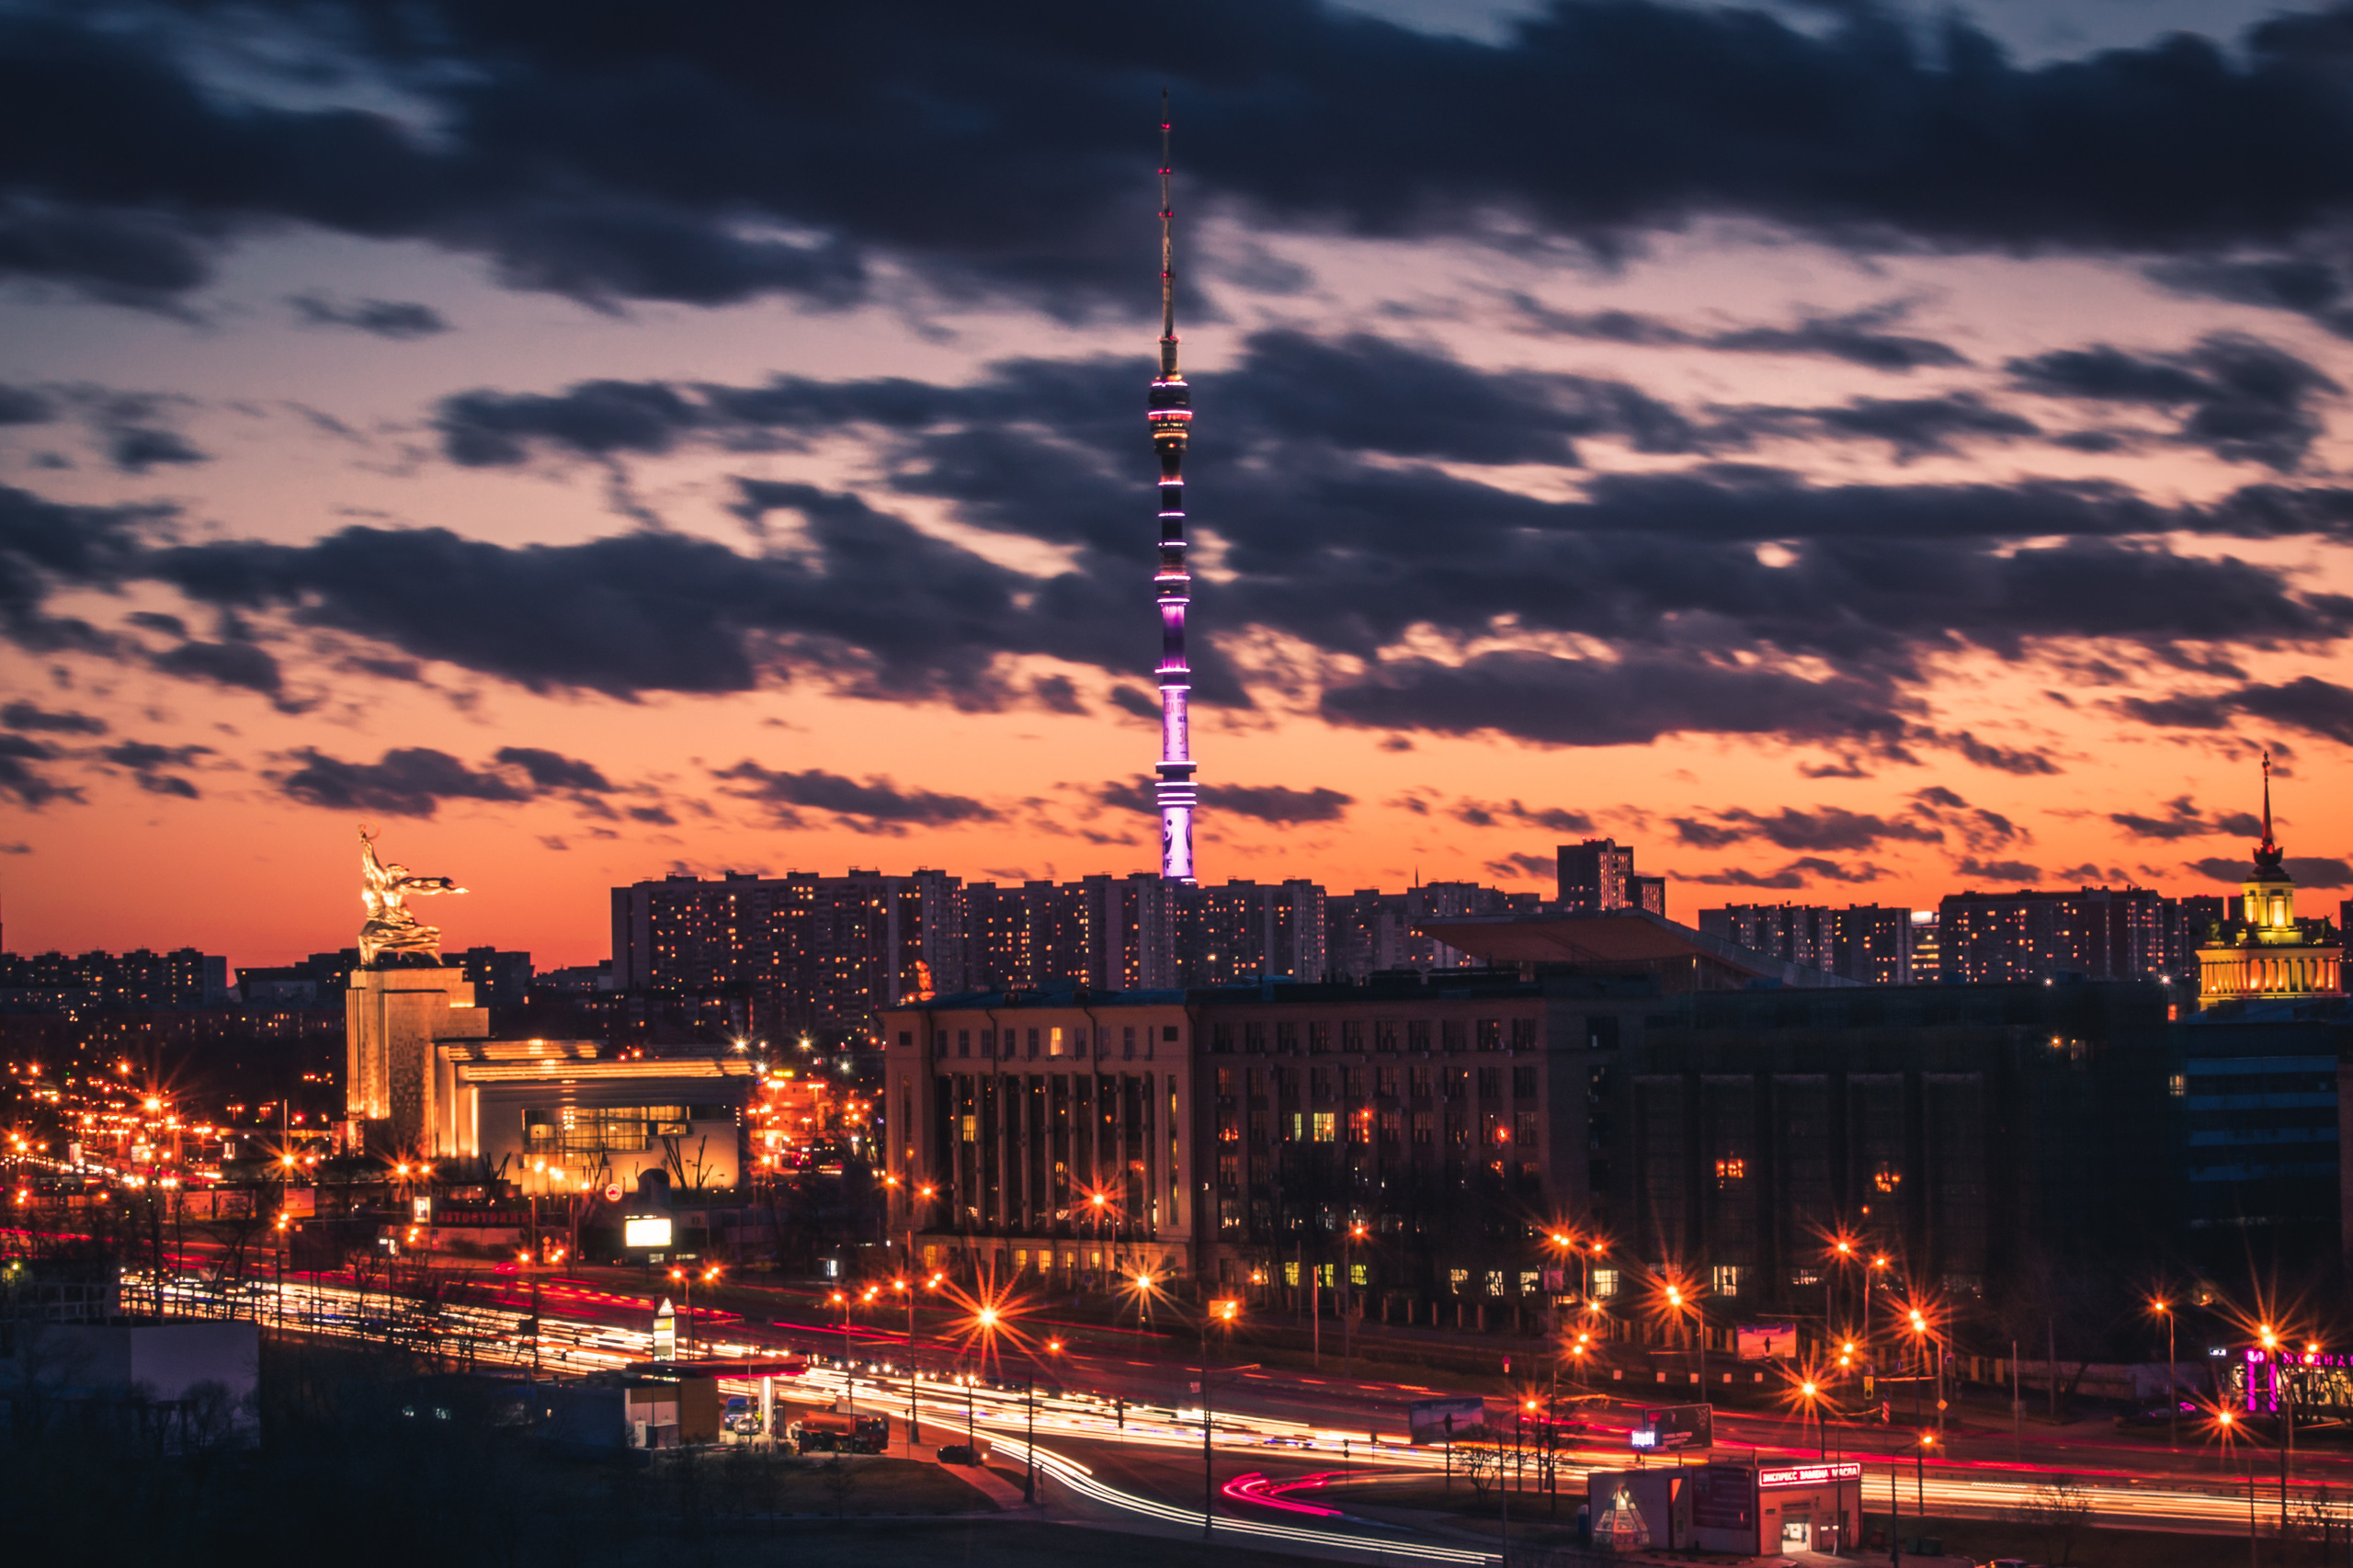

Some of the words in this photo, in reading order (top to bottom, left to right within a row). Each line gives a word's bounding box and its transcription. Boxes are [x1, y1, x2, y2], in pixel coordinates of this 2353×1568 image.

[2283, 1351, 2353, 1368] МОДНА
[1762, 1471, 1797, 1483] ЭКСПРЕСС
[1800, 1469, 1829, 1481] ЗАМЕНА
